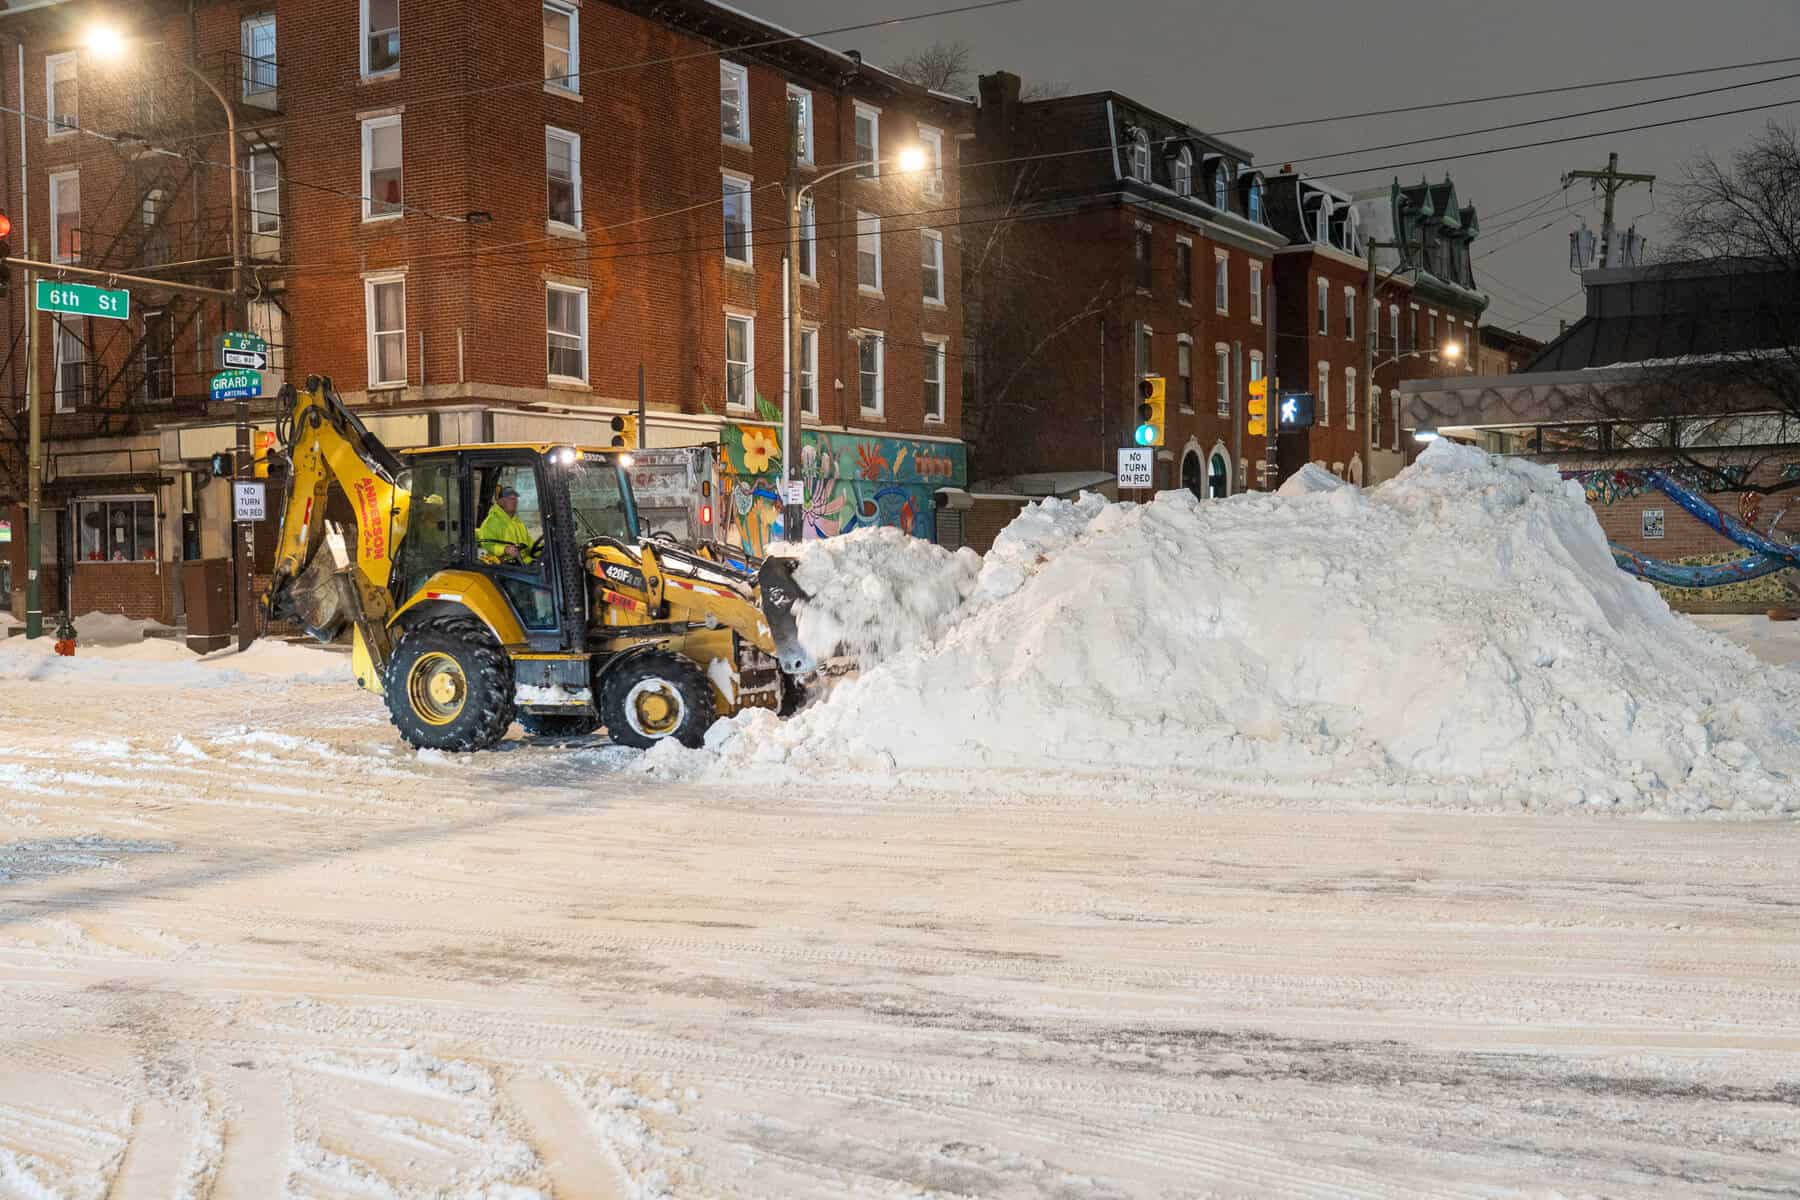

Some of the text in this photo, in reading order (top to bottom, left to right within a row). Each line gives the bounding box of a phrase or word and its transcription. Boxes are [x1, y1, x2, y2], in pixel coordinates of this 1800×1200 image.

[50, 290, 118, 312] 6th St
[213, 376, 248, 390] GIRARD
[215, 390, 220, 399] E
[1129, 452, 1142, 461] NO
[1124, 463, 1147, 472] TURN
[1120, 474, 1151, 483] ON RED
[243, 487, 256, 495] NO
[240, 497, 261, 506] TURN
[238, 508, 263, 517] ON RED
[361, 478, 385, 560] ANDERSON
